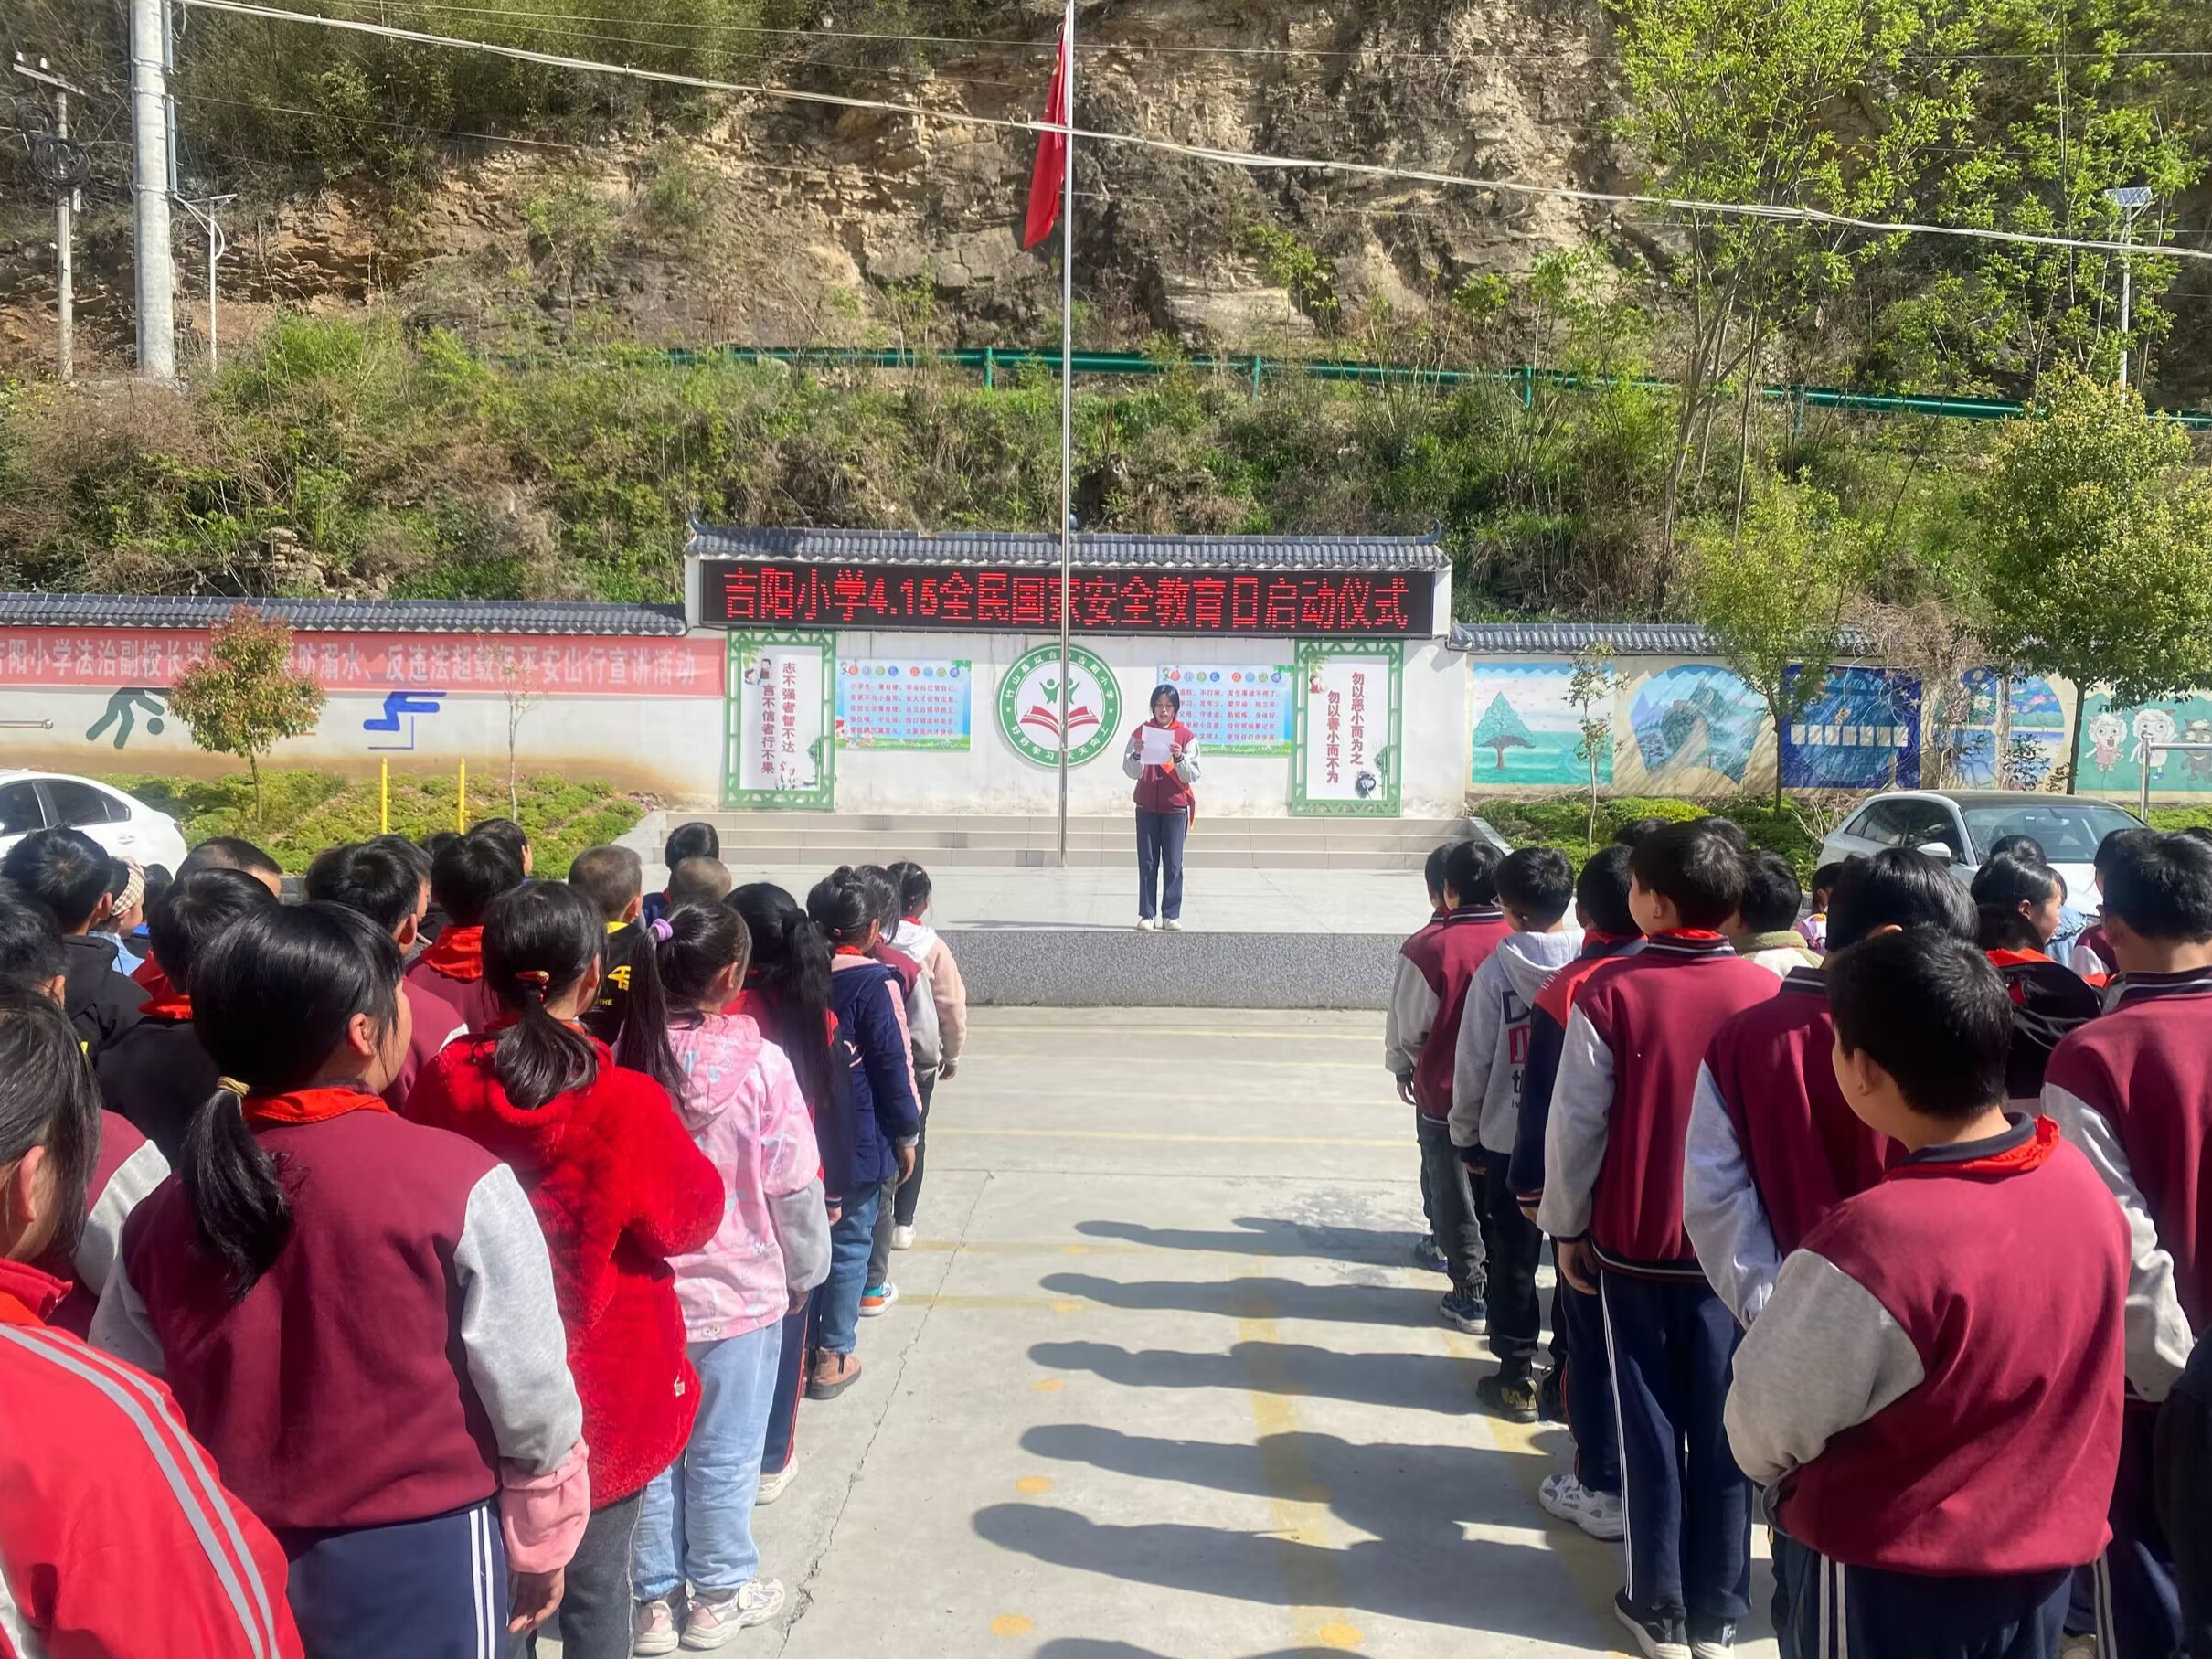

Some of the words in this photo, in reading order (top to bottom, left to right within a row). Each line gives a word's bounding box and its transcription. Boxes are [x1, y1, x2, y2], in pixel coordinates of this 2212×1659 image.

[724, 567, 1409, 630] 吉阳小学4.15全民国家安全教育日启动仪式
[761, 684, 776, 774] 言不信者行不果
[782, 662, 796, 753] 志不强者智不达
[1326, 690, 1341, 783] 勿以善小而不为
[1350, 672, 1365, 765] 勿以恶小而为之
